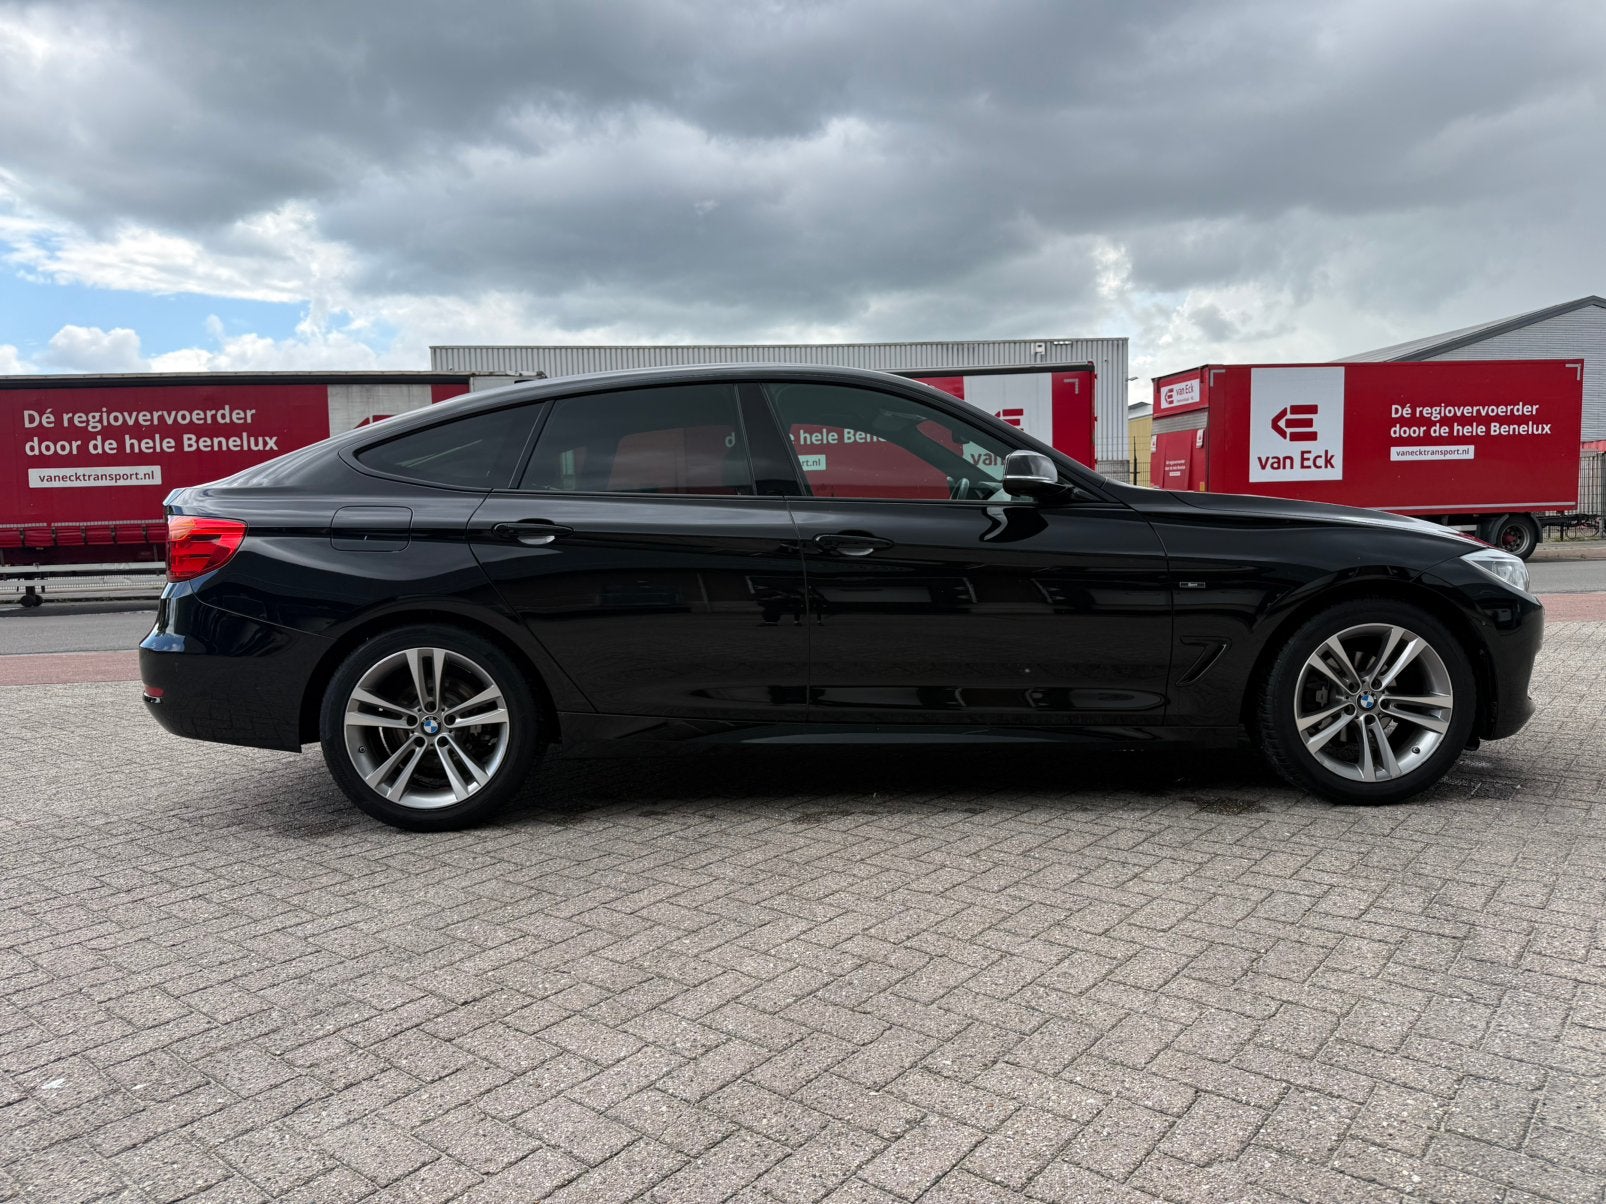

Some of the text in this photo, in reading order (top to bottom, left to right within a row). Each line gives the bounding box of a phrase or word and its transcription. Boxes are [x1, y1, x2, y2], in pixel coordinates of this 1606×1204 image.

[23, 405, 256, 432] Dé regiovervoerder
[1391, 401, 1540, 421] Dé regiovervoerder
[800, 428, 838, 445] hele
[1390, 421, 1551, 438] door de hele Benelux
[25, 432, 279, 456] door de hele Benelux
[1396, 447, 1470, 457] vanecktransport.nl
[1257, 449, 1335, 471] van Eck
[38, 470, 155, 484] vanecktransport.nl
